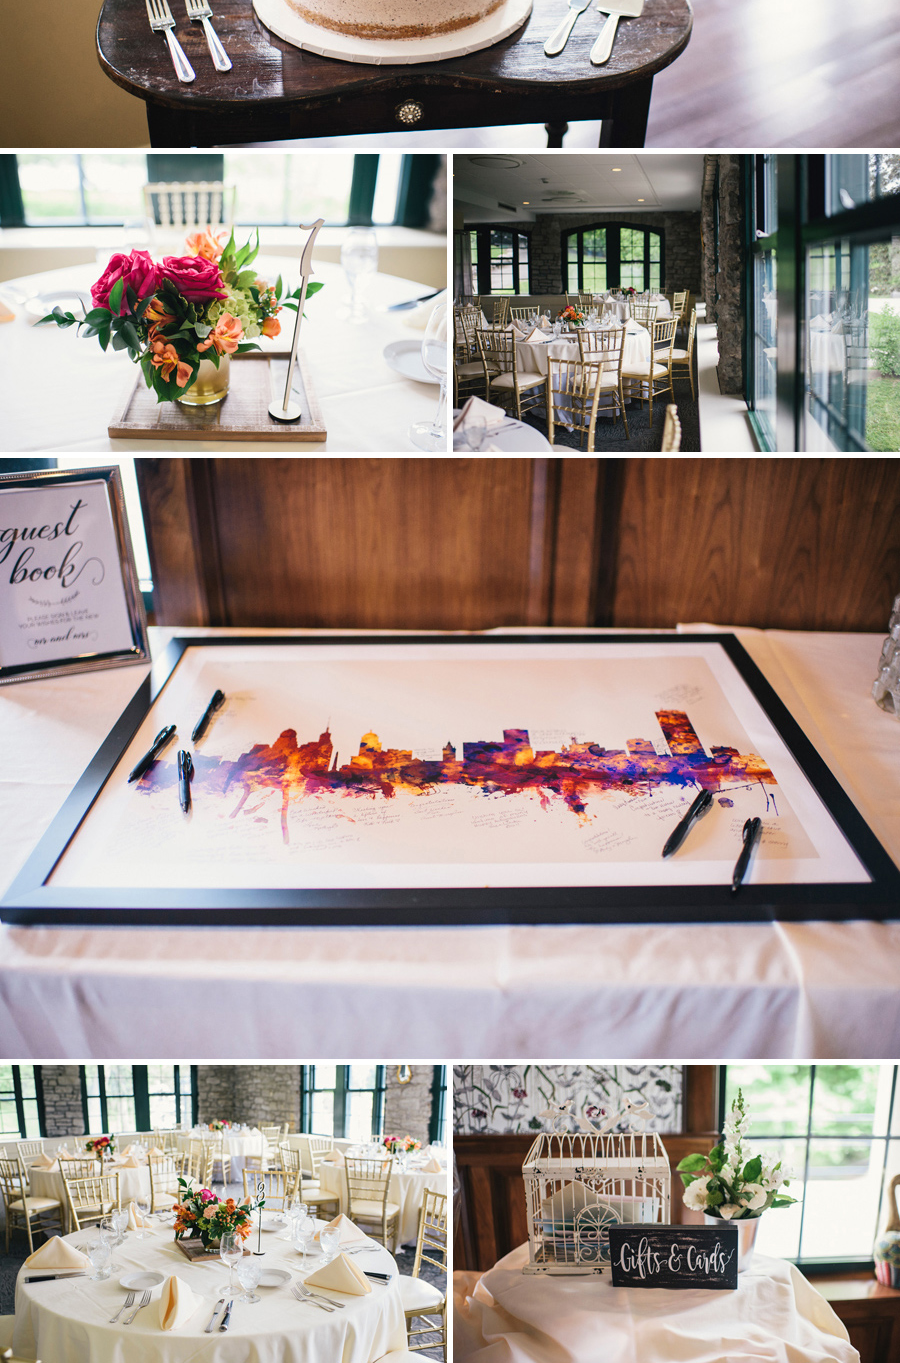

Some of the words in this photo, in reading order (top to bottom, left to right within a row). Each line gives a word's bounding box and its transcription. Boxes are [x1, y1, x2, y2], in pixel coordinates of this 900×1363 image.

[0, 499, 88, 564] guest
[9, 541, 105, 588] book
[613, 1237, 668, 1279] Gifts
[668, 1243, 683, 1272] &
[687, 1242, 736, 1274] Cards
